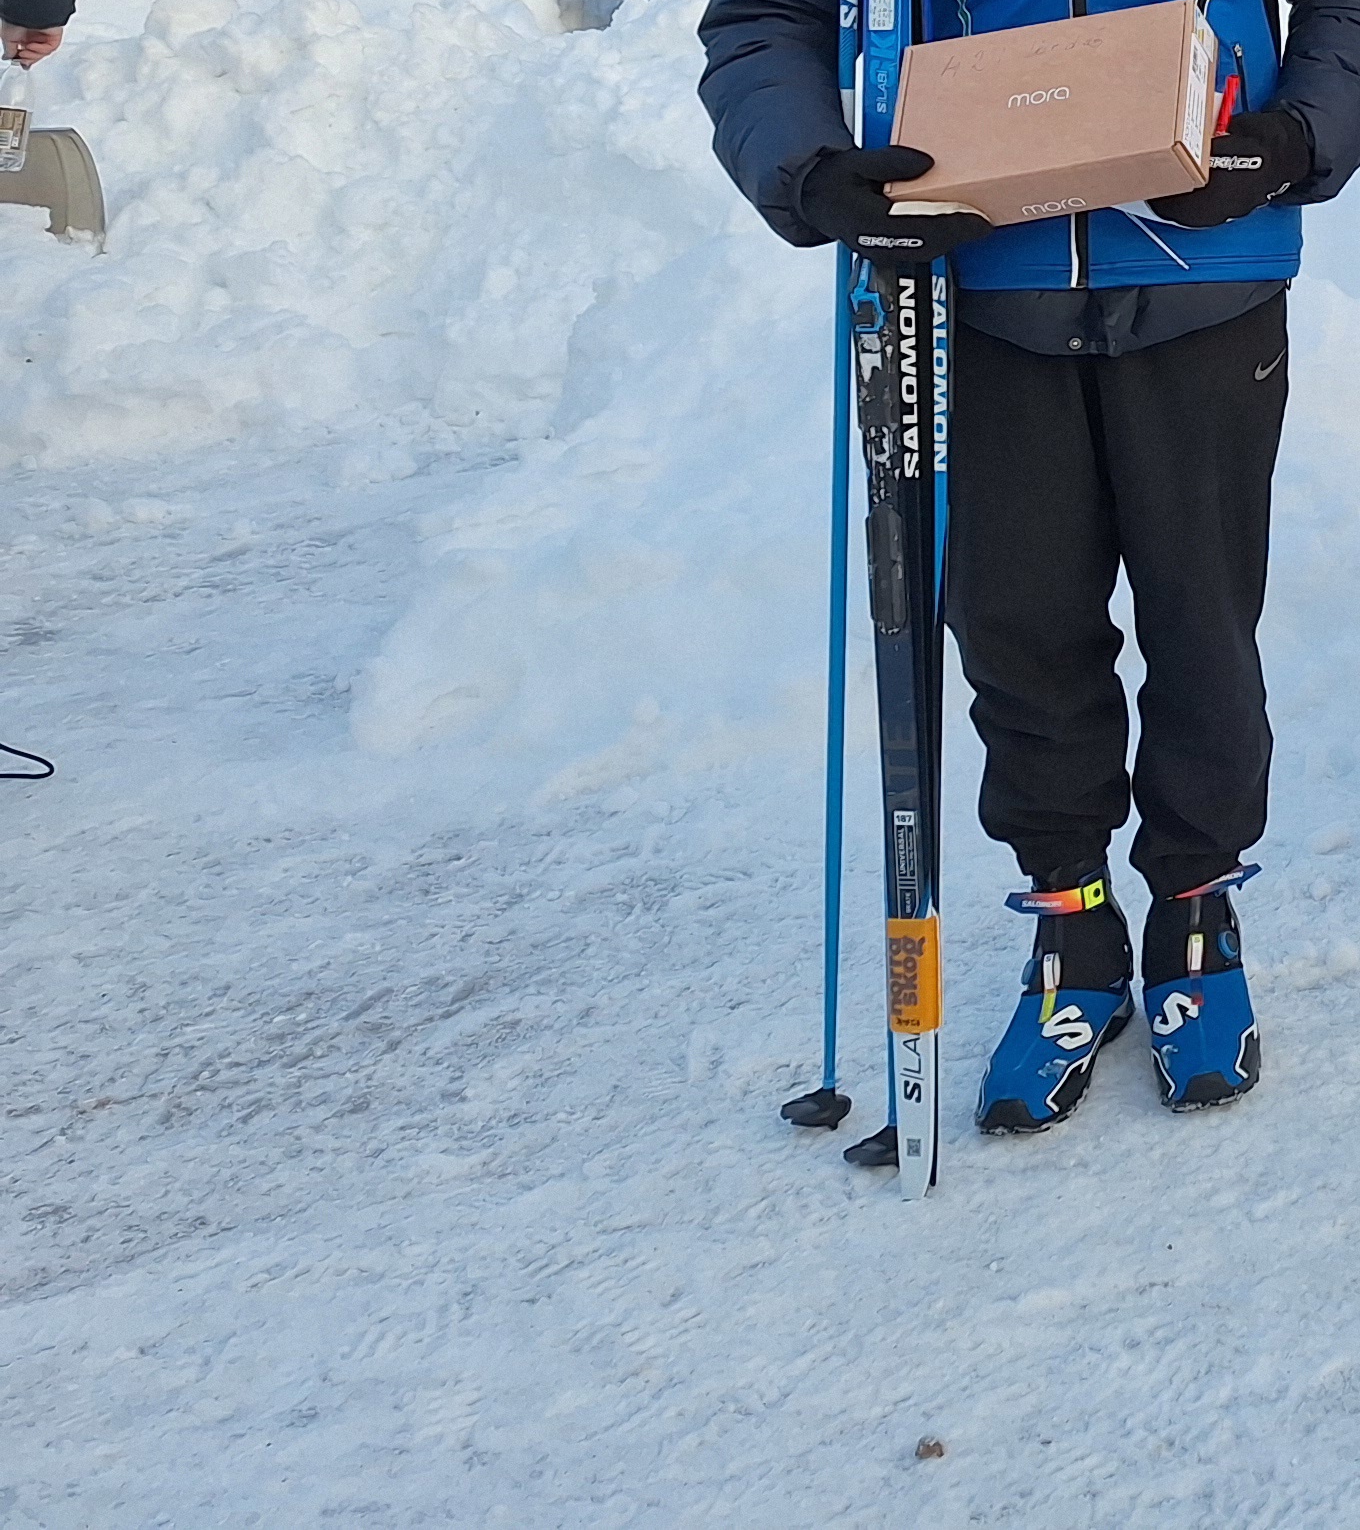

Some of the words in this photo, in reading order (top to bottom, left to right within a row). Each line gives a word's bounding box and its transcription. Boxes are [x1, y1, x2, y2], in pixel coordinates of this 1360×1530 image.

[1007, 86, 1070, 109] mora
[1021, 197, 1087, 217] mora
[898, 277, 920, 479] SALOMON
[931, 274, 948, 473] SALOMON
[900, 935, 926, 1007] skog
[899, 1033, 925, 1103] S/LA
